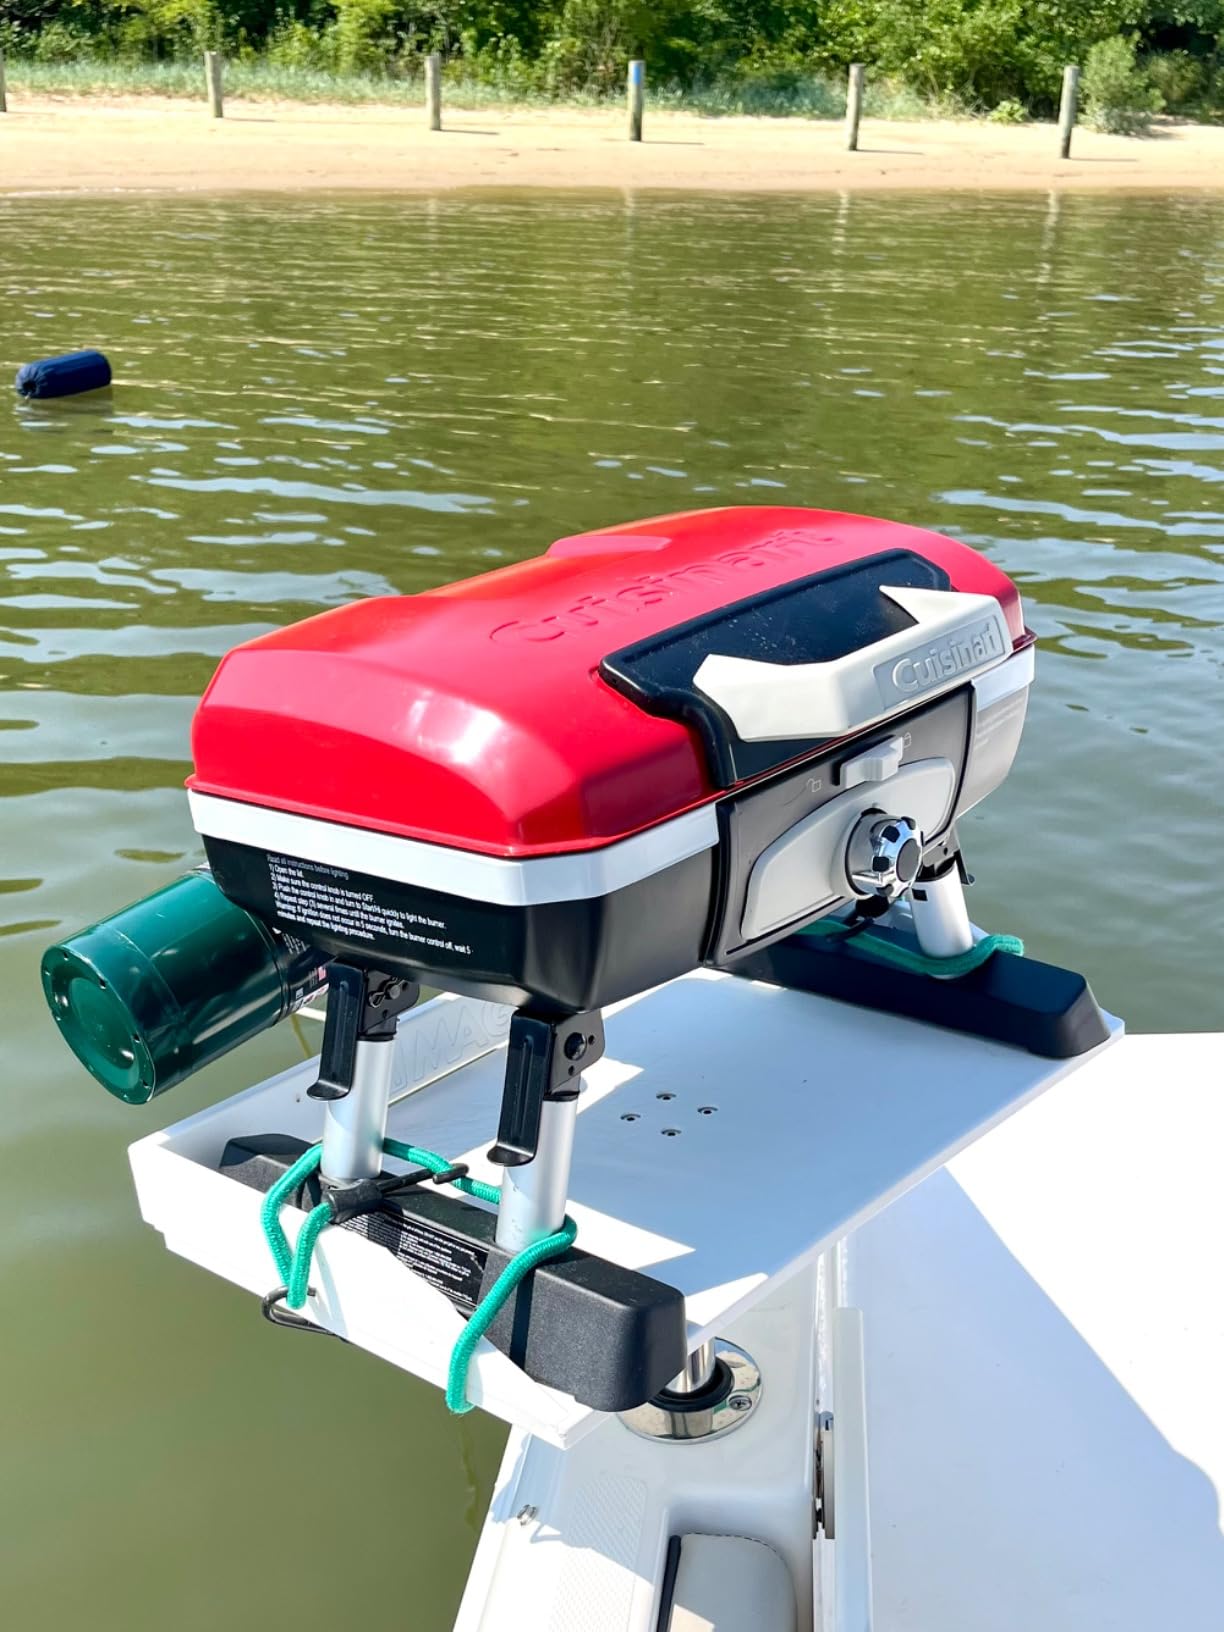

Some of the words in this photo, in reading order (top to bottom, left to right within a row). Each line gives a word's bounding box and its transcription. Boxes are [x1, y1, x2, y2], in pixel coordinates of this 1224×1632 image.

[489, 528, 841, 644] Cuisinart
[891, 623, 1001, 692] Cuisinart
[275, 865, 287, 875] Open
[287, 867, 296, 875] the
